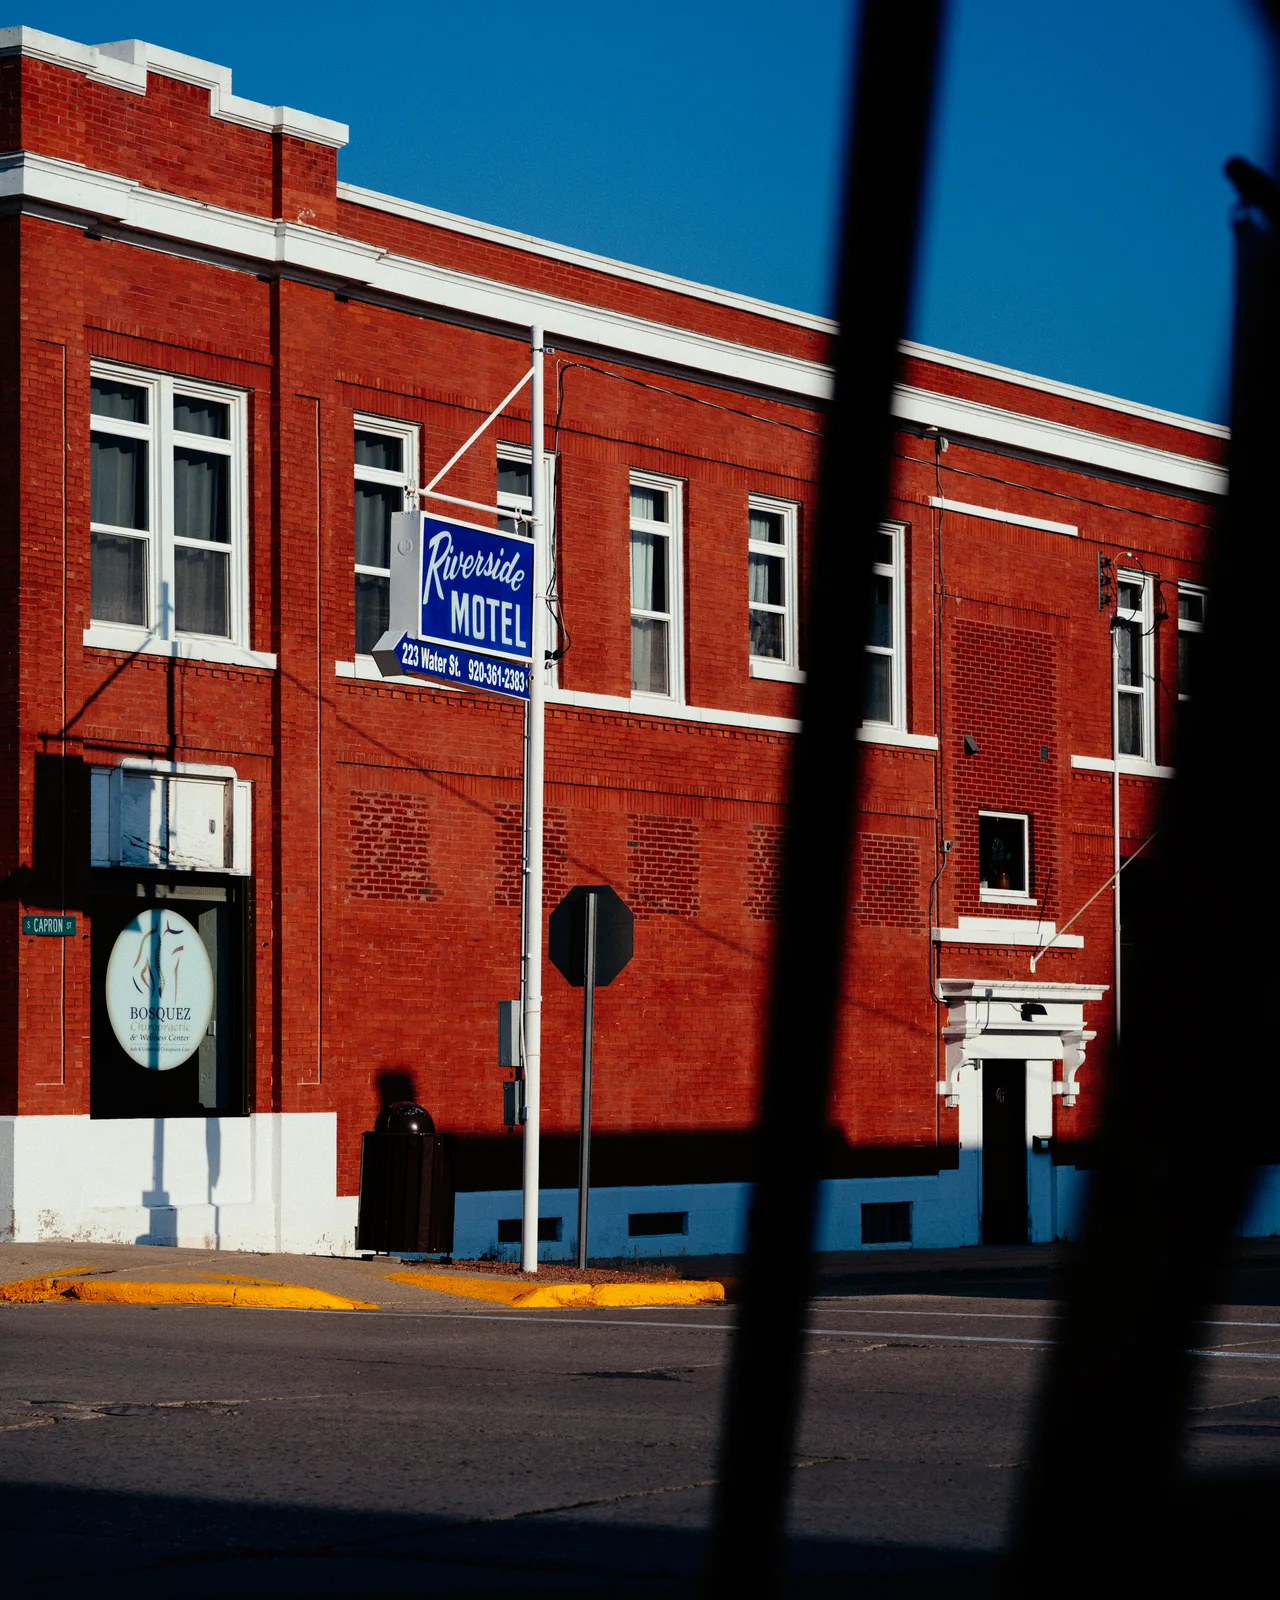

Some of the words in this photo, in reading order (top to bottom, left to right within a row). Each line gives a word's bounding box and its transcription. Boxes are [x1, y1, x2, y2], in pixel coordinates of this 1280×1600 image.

[422, 530, 525, 605] Riverside
[451, 590, 527, 649] MOTEL
[402, 642, 419, 667] 223
[421, 646, 447, 674] Water
[449, 653, 461, 677] St.
[468, 658, 525, 693] 920-361-2383
[26, 920, 31, 930] S
[33, 918, 64, 933] CAPRON
[66, 921, 72, 930] ST
[130, 1006, 191, 1022] BOSQUEZ
[130, 1021, 191, 1034] Chiropractic
[129, 1033, 138, 1041] &
[139, 1033, 167, 1041] Wellness
[168, 1033, 190, 1042] Center
